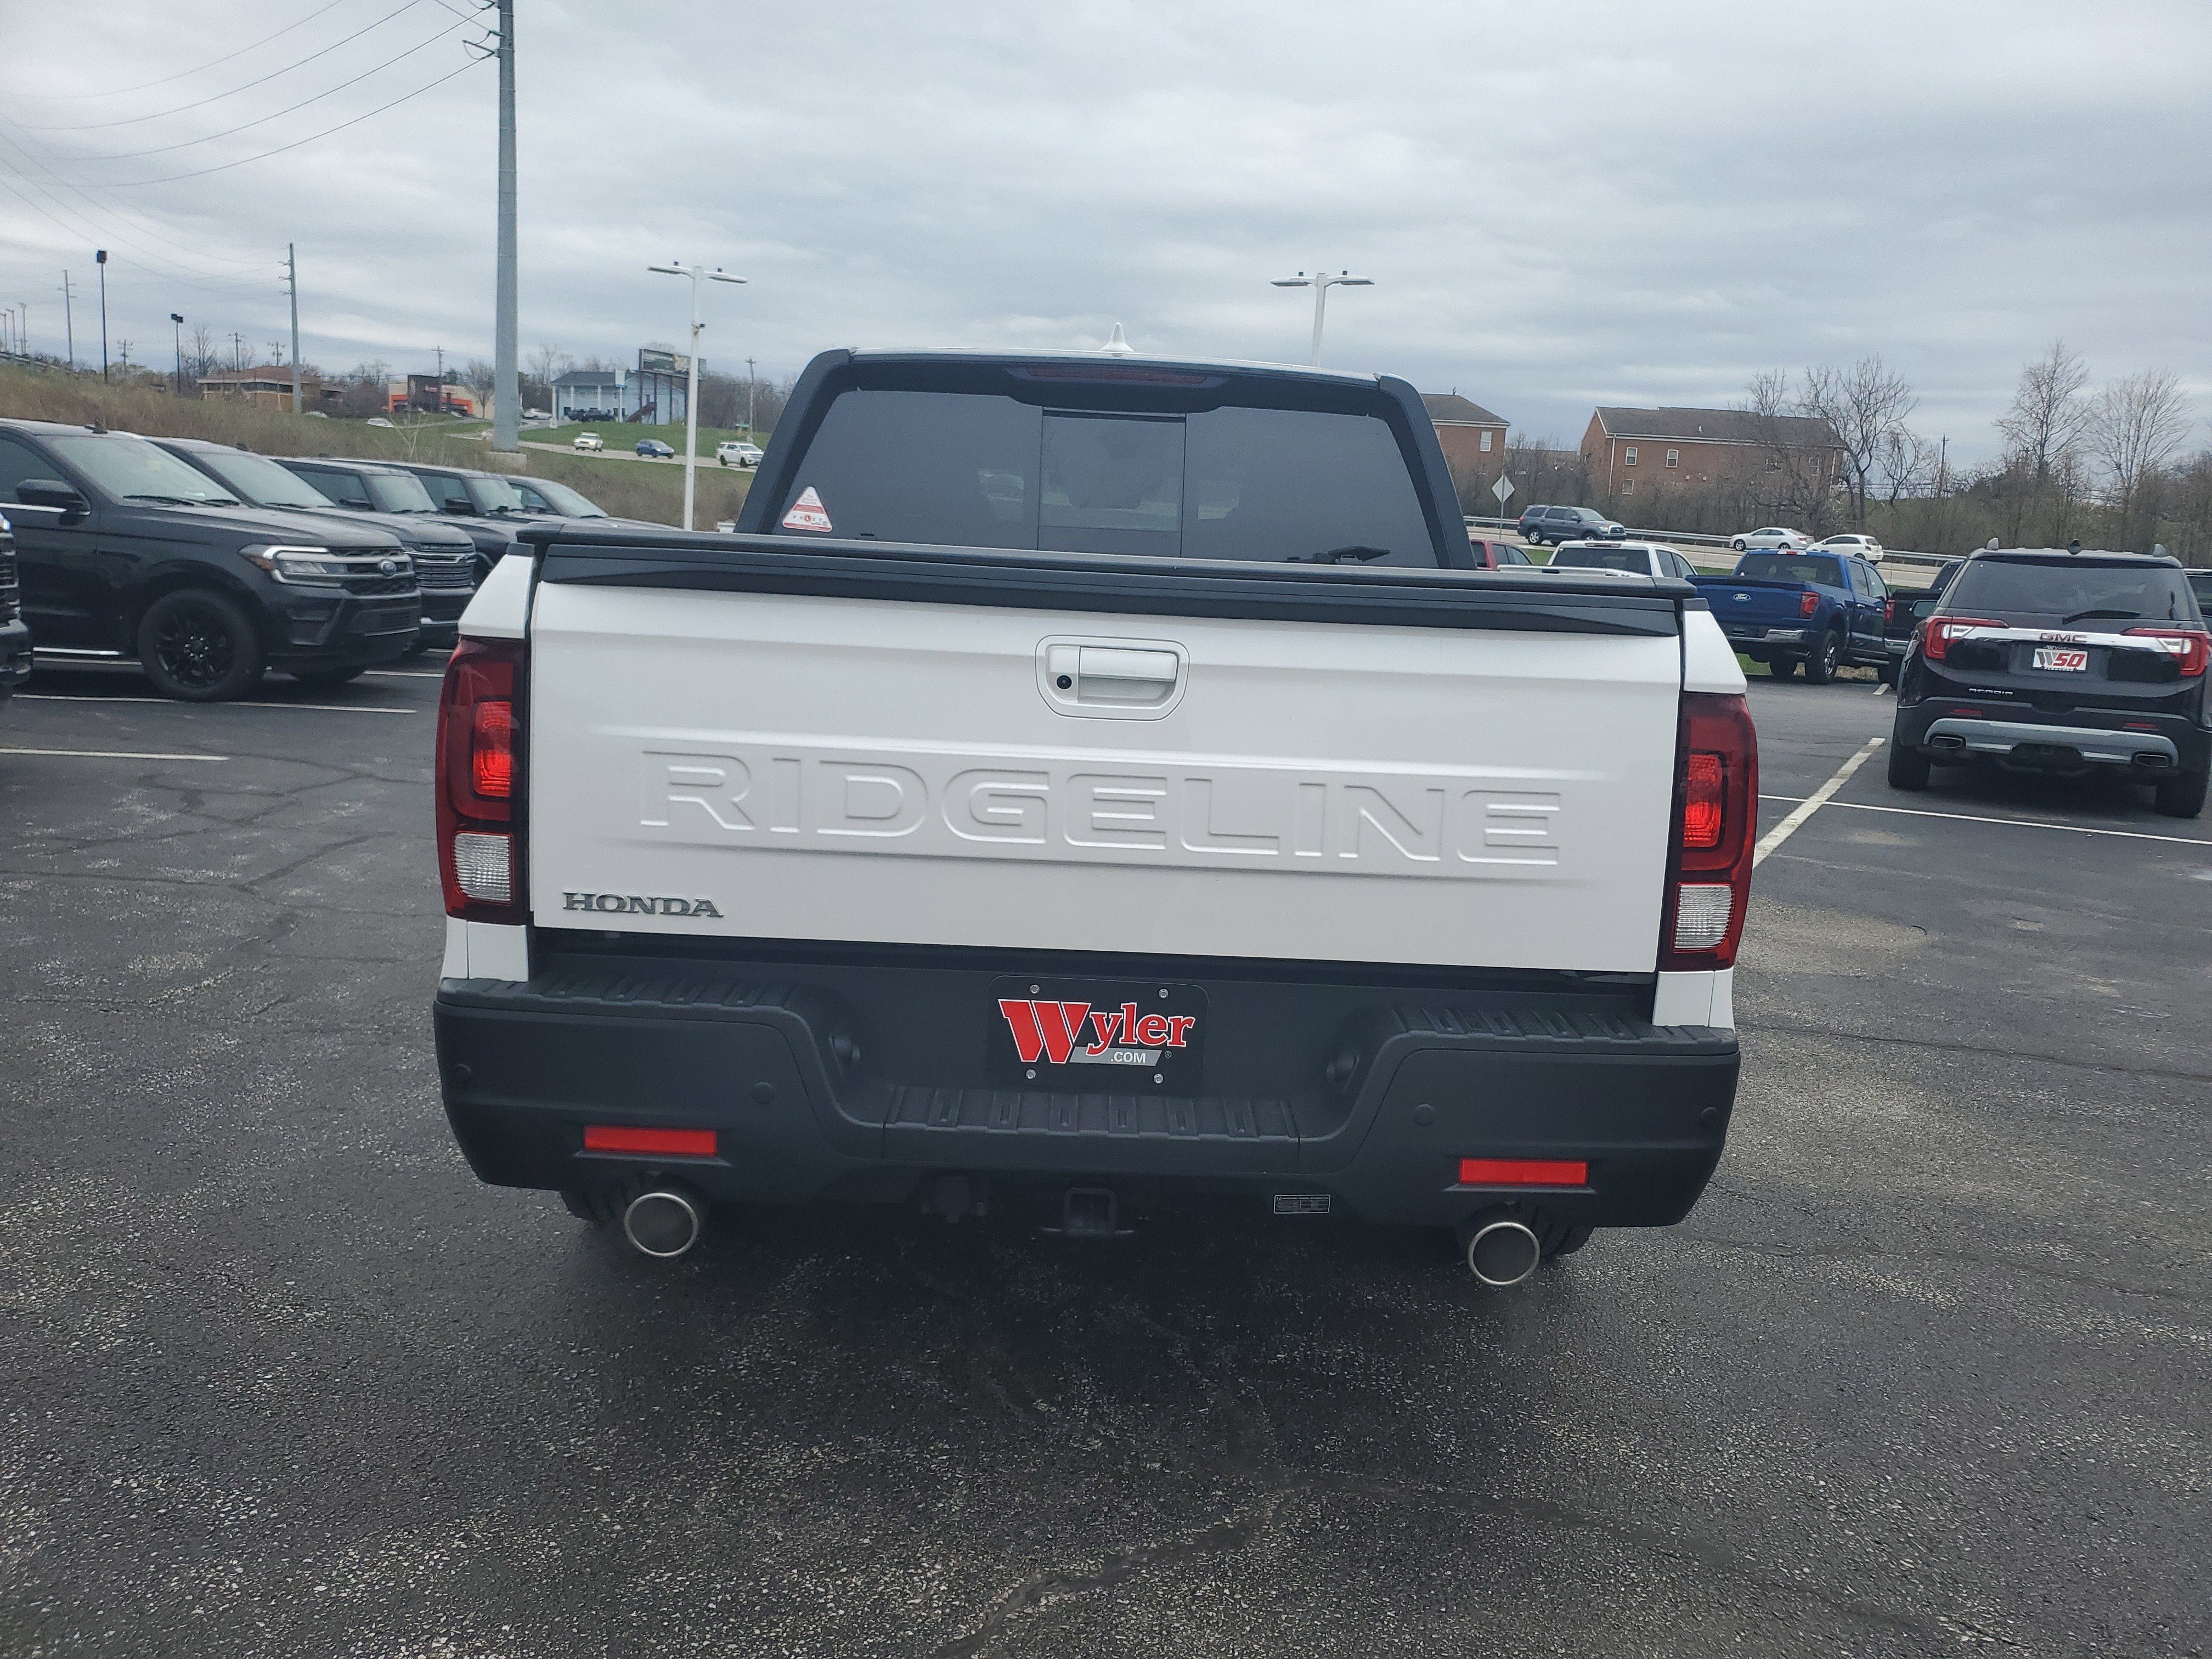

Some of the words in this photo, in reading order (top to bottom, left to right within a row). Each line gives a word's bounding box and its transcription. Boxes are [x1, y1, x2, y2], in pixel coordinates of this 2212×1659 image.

[2040, 633, 2087, 642] GMC
[640, 751, 1561, 865] RIDGELINE
[562, 891, 724, 918] HONDA
[997, 998, 1195, 1064] Wyler
